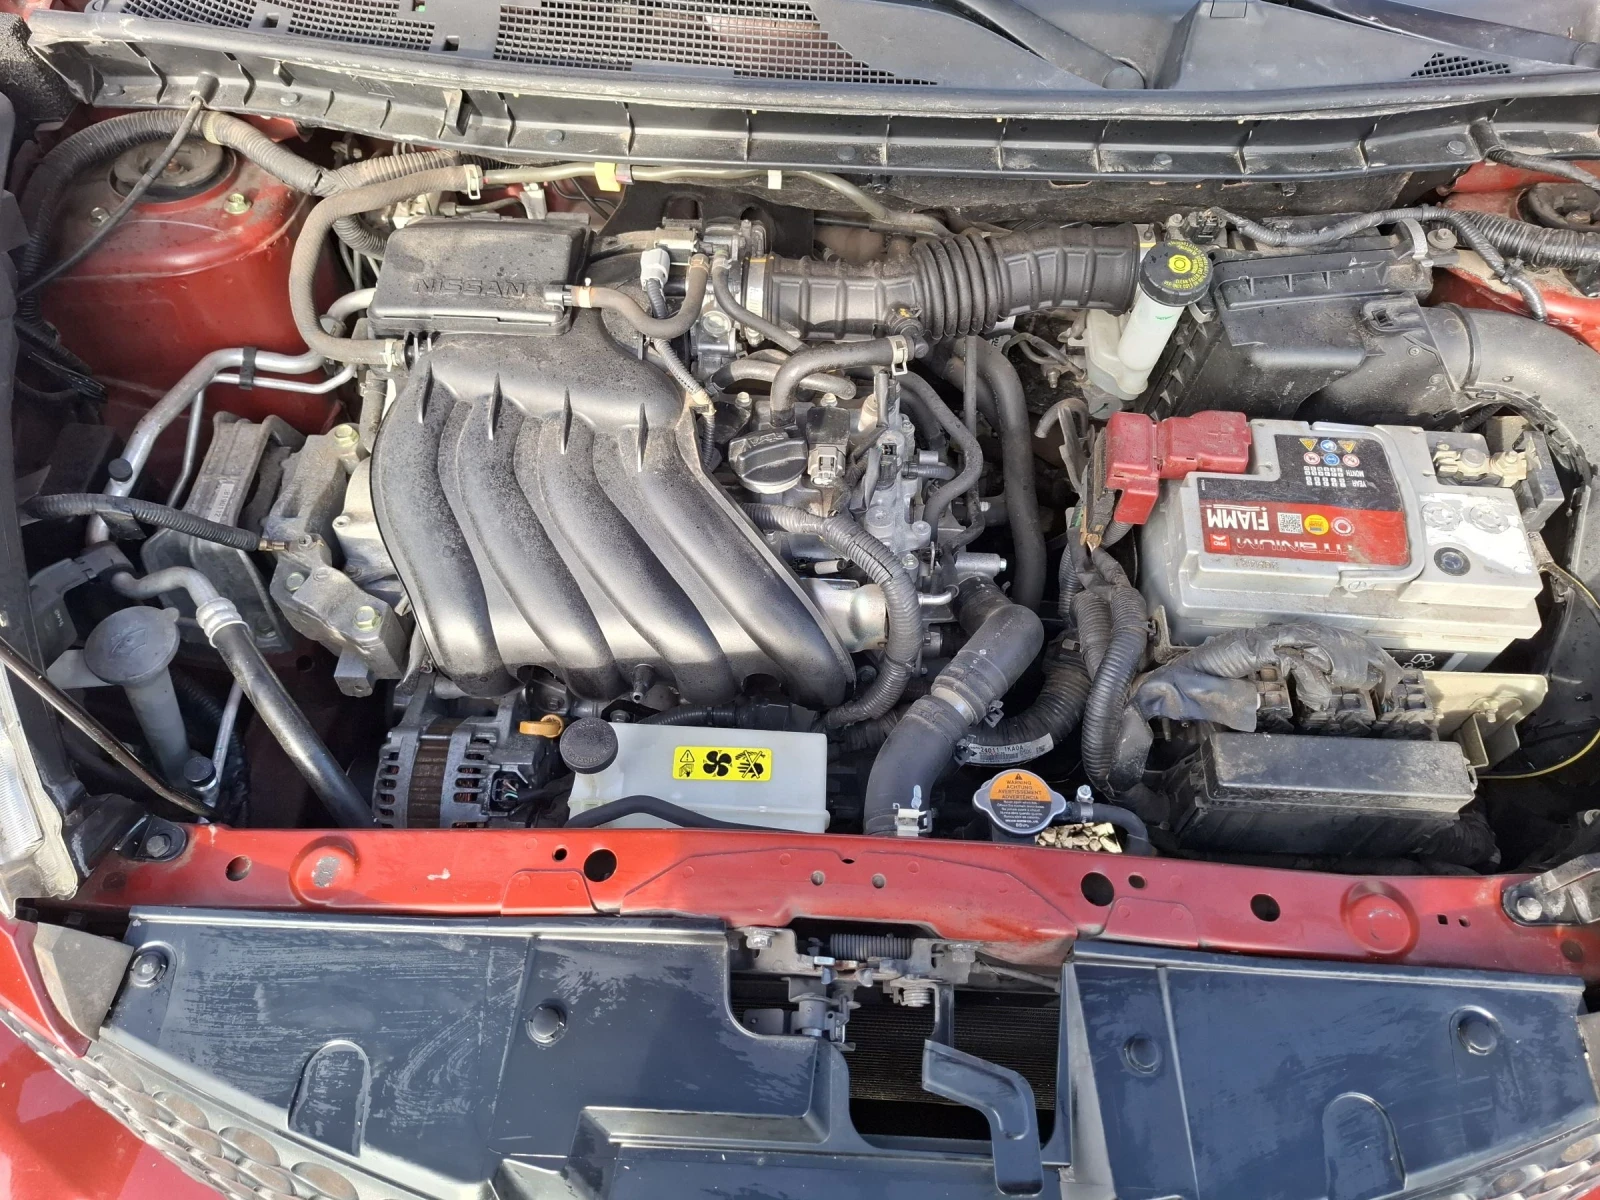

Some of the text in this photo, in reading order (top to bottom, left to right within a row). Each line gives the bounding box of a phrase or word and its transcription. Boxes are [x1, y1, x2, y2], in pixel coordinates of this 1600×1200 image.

[414, 279, 525, 298] NISSAN
[1345, 470, 1365, 478] MONTH
[1351, 480, 1367, 488] YEAR
[1206, 509, 1270, 531] FIAMM
